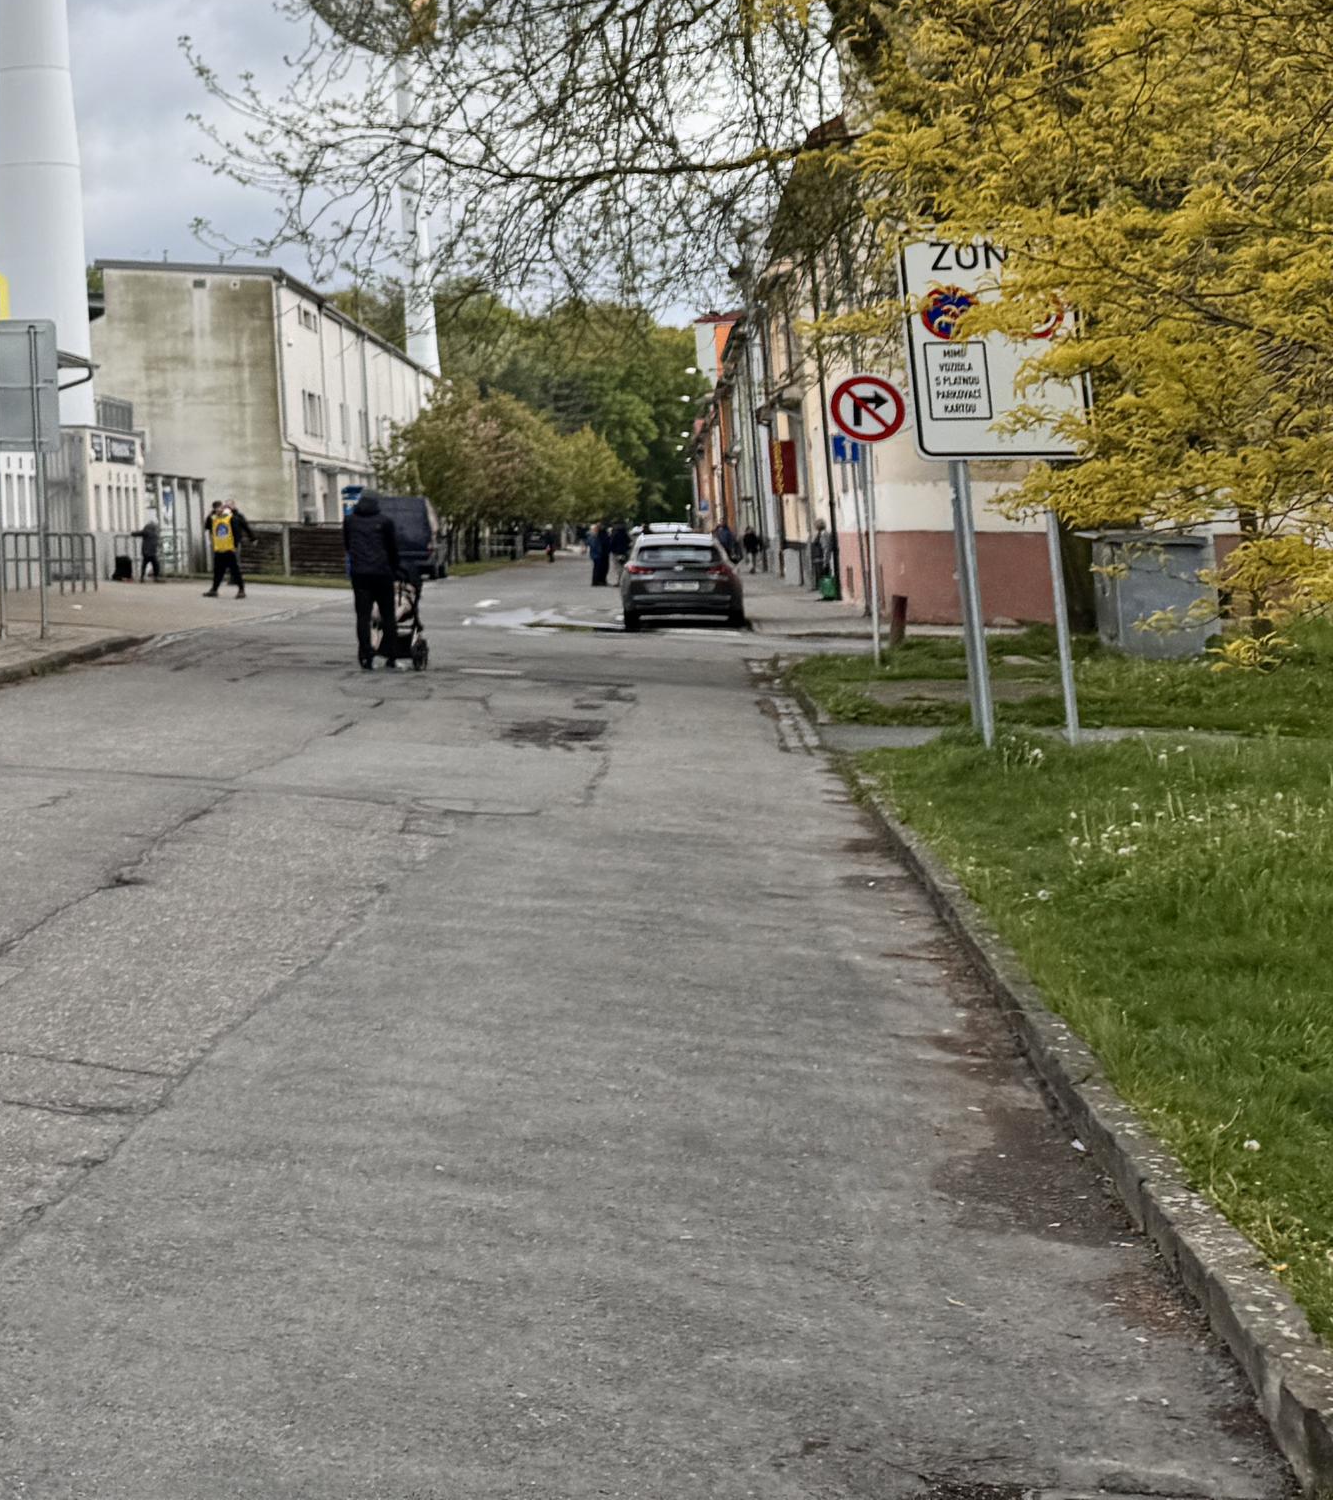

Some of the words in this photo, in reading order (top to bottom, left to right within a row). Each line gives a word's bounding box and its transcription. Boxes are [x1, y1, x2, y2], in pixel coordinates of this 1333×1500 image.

[939, 362, 973, 372] VOZIDLA
[935, 375, 941, 386] S
[943, 375, 980, 386] PLATNOU
[944, 403, 977, 414] KARTOU
